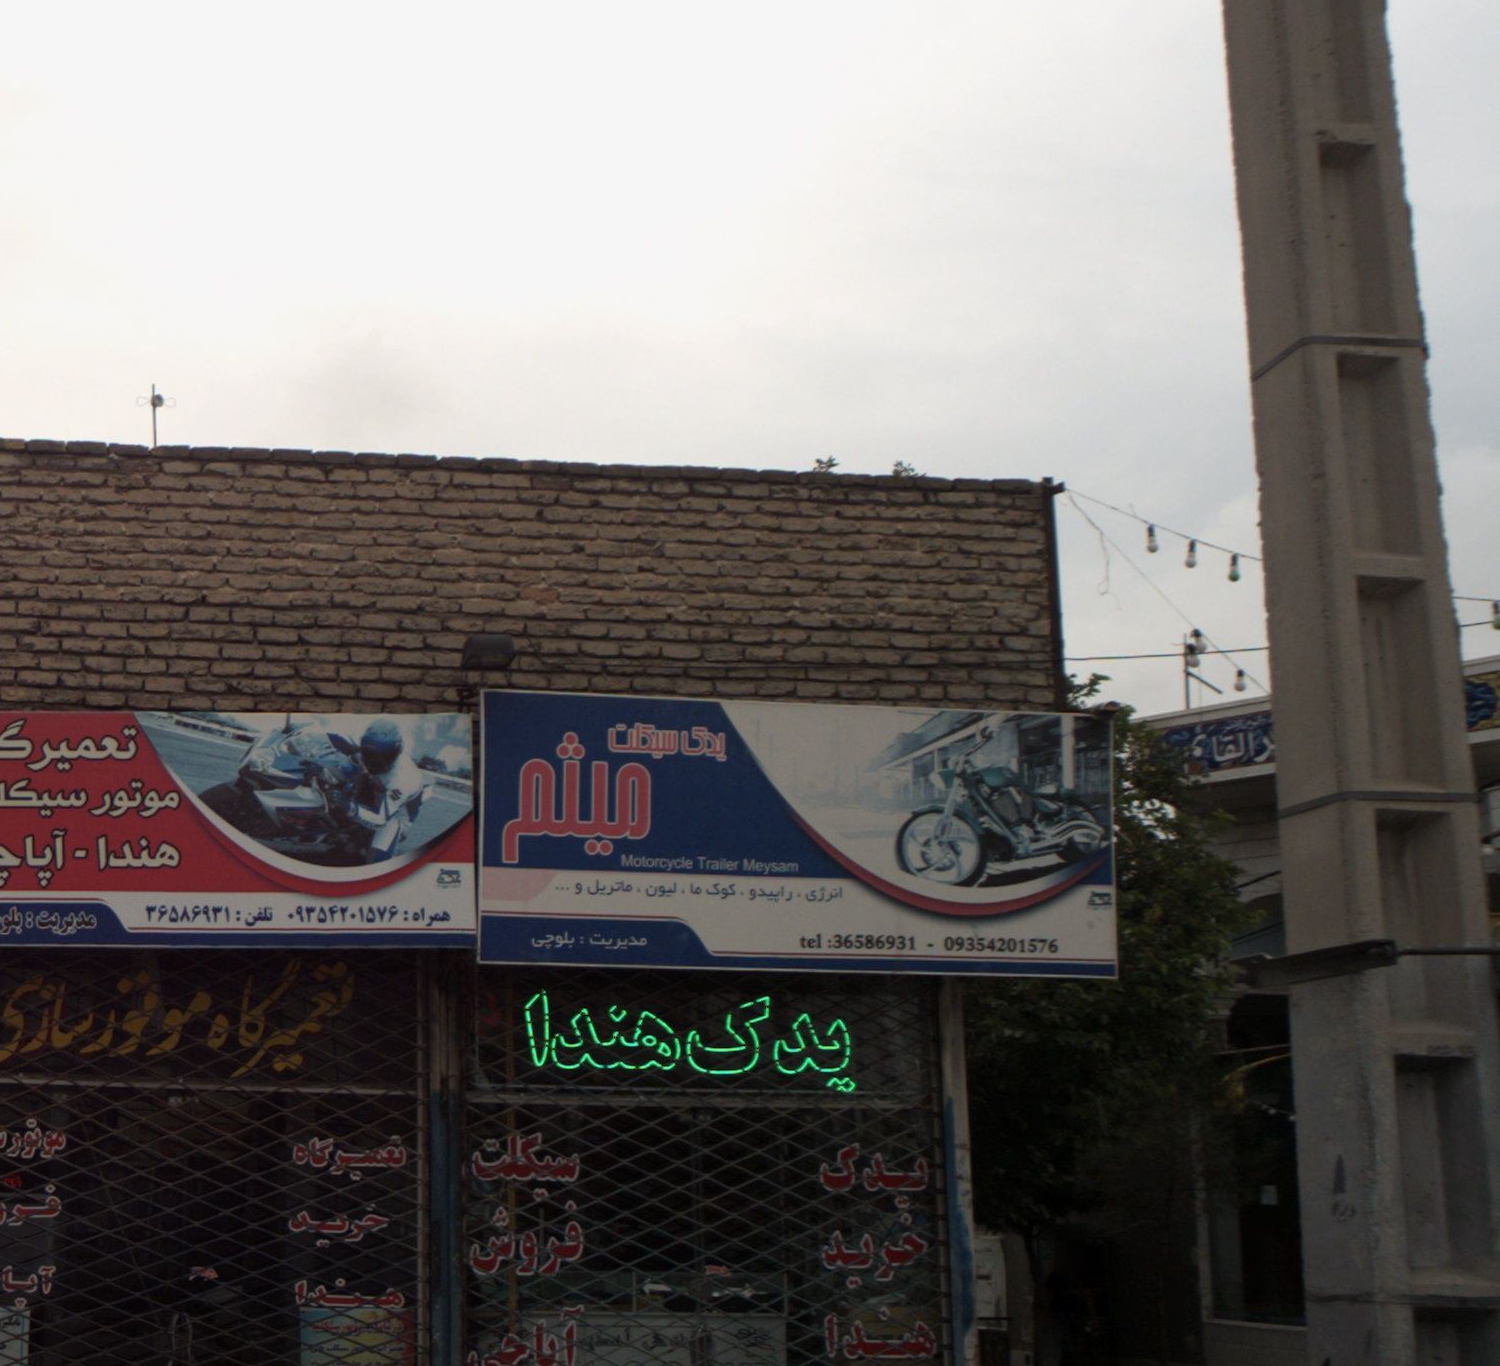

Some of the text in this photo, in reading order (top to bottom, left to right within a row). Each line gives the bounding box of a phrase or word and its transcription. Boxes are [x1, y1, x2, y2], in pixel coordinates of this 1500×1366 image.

[502, 730, 652, 865] میثم
[96, 835, 182, 872] هندا
[620, 853, 799, 877] Motorcycle Trailer Meysam
[35, 910, 98, 935] مدیریت
[531, 930, 648, 952] مدیریت بلوچی
[944, 936, 1059, 955] 09354201576
[523, 988, 682, 1071] هندا
[471, 1132, 581, 1203] سیکلت
[288, 1203, 390, 1248] خرید
[469, 1200, 929, 1290] خرید فروش
